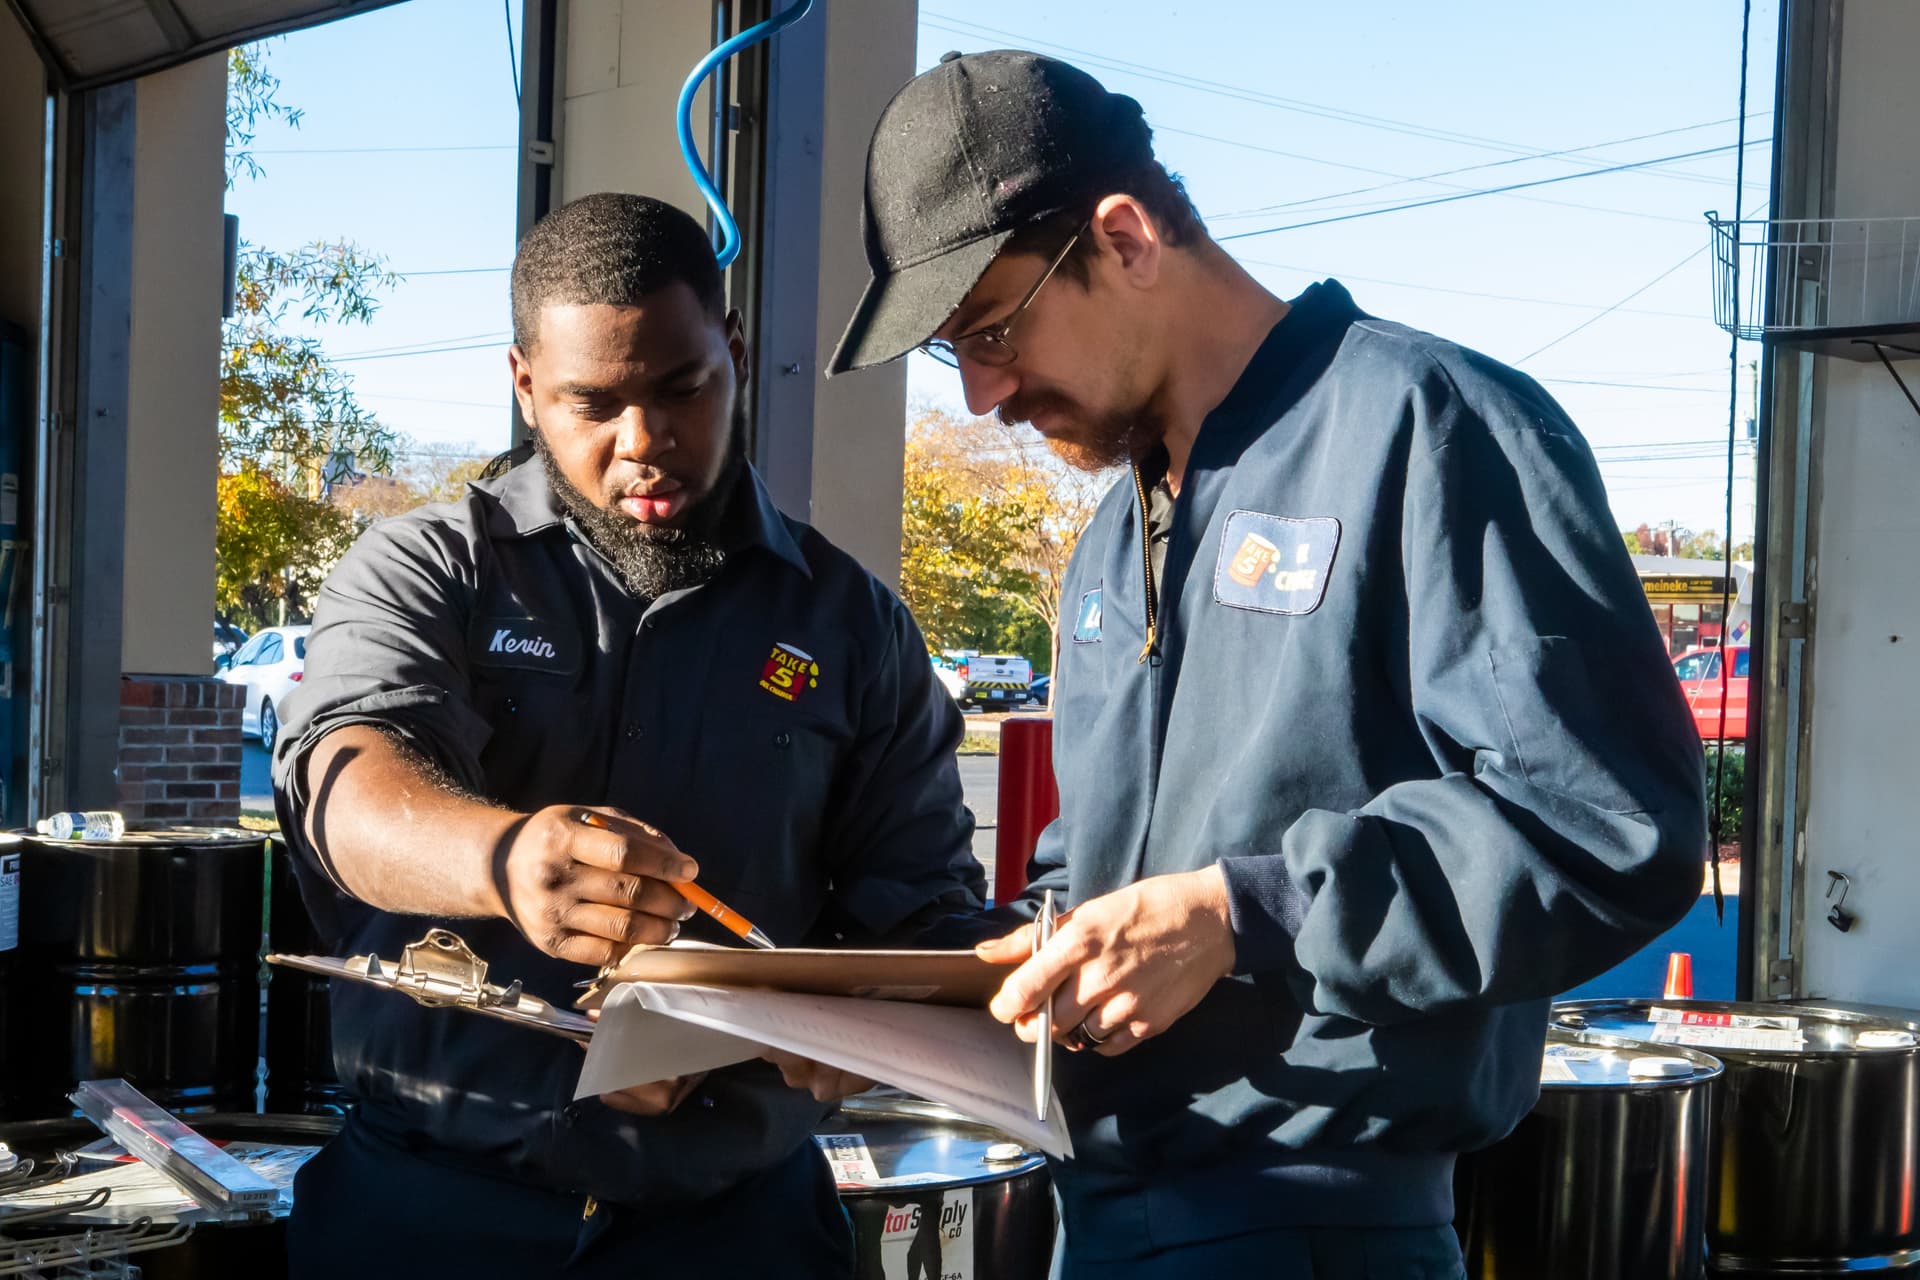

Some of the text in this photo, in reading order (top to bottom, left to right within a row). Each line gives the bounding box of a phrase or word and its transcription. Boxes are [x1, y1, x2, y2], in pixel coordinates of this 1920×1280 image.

[1644, 579, 1688, 592] meineke
[489, 629, 556, 658] Kevin
[770, 647, 808, 674] TAKE
[769, 667, 794, 688] 5
